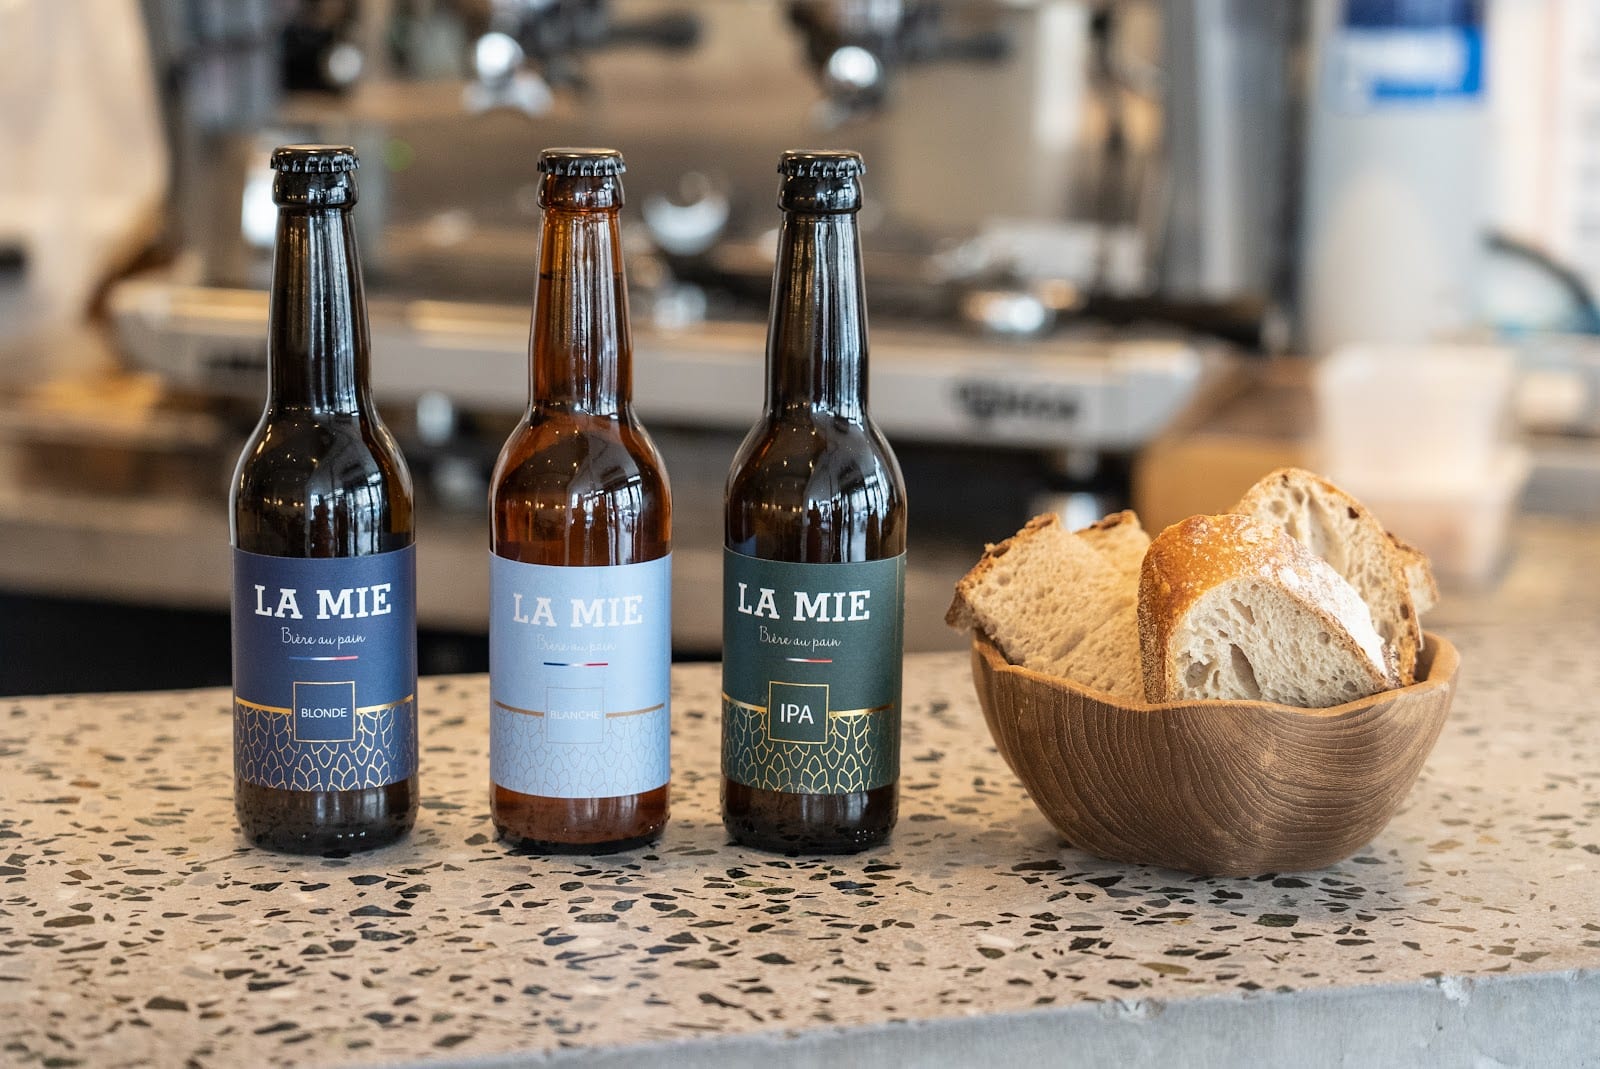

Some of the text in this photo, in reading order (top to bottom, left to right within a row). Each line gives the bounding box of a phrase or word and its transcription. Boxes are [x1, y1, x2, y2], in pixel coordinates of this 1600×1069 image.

[255, 583, 391, 619] LA MIE
[513, 593, 643, 627] LA MIE
[738, 583, 870, 622] LA MIE
[281, 627, 366, 650] Bière au pain
[760, 626, 841, 652] Bière au pain
[302, 708, 347, 719] BLONDE
[550, 711, 601, 720] BLANCHE
[780, 704, 814, 724] IPA
